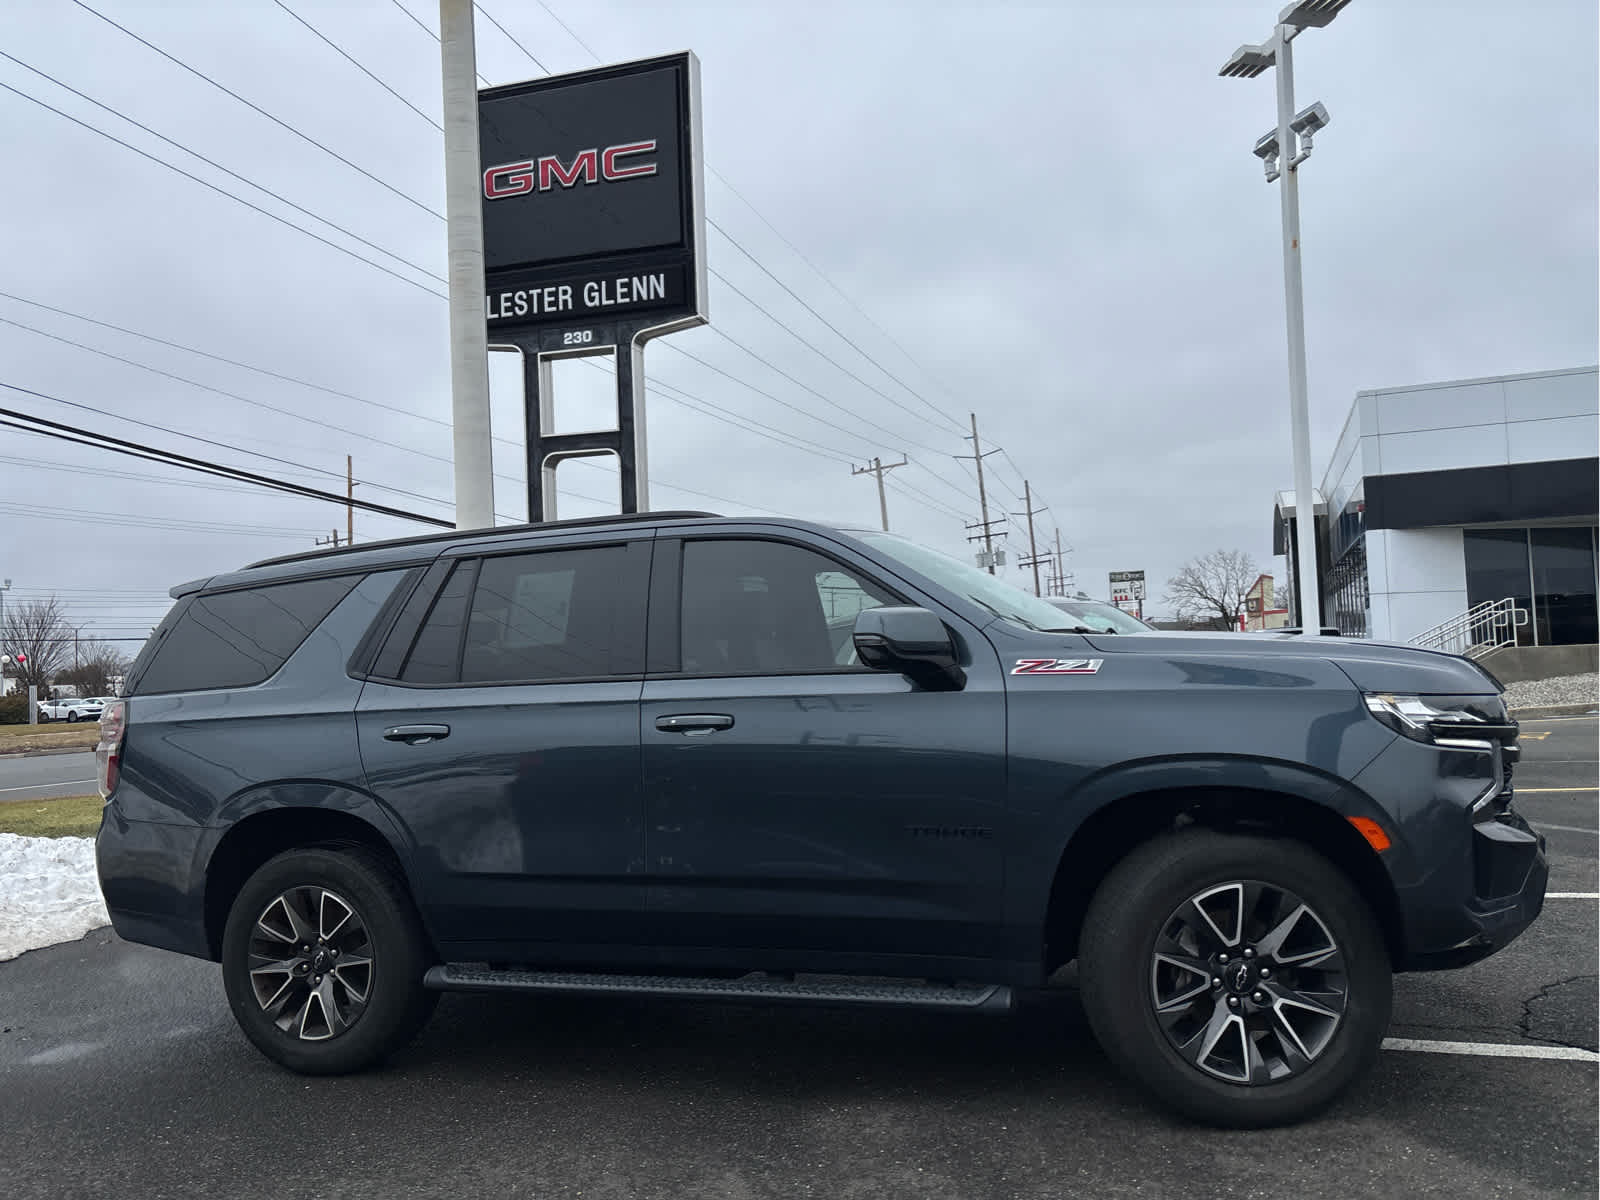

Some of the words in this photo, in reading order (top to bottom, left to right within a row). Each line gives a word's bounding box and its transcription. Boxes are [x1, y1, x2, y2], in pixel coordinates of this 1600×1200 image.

[483, 139, 657, 199] GMC
[486, 286, 573, 319] LESTER
[583, 273, 665, 308] GLENN
[563, 330, 593, 344] 230
[1010, 659, 1104, 675] Z71
